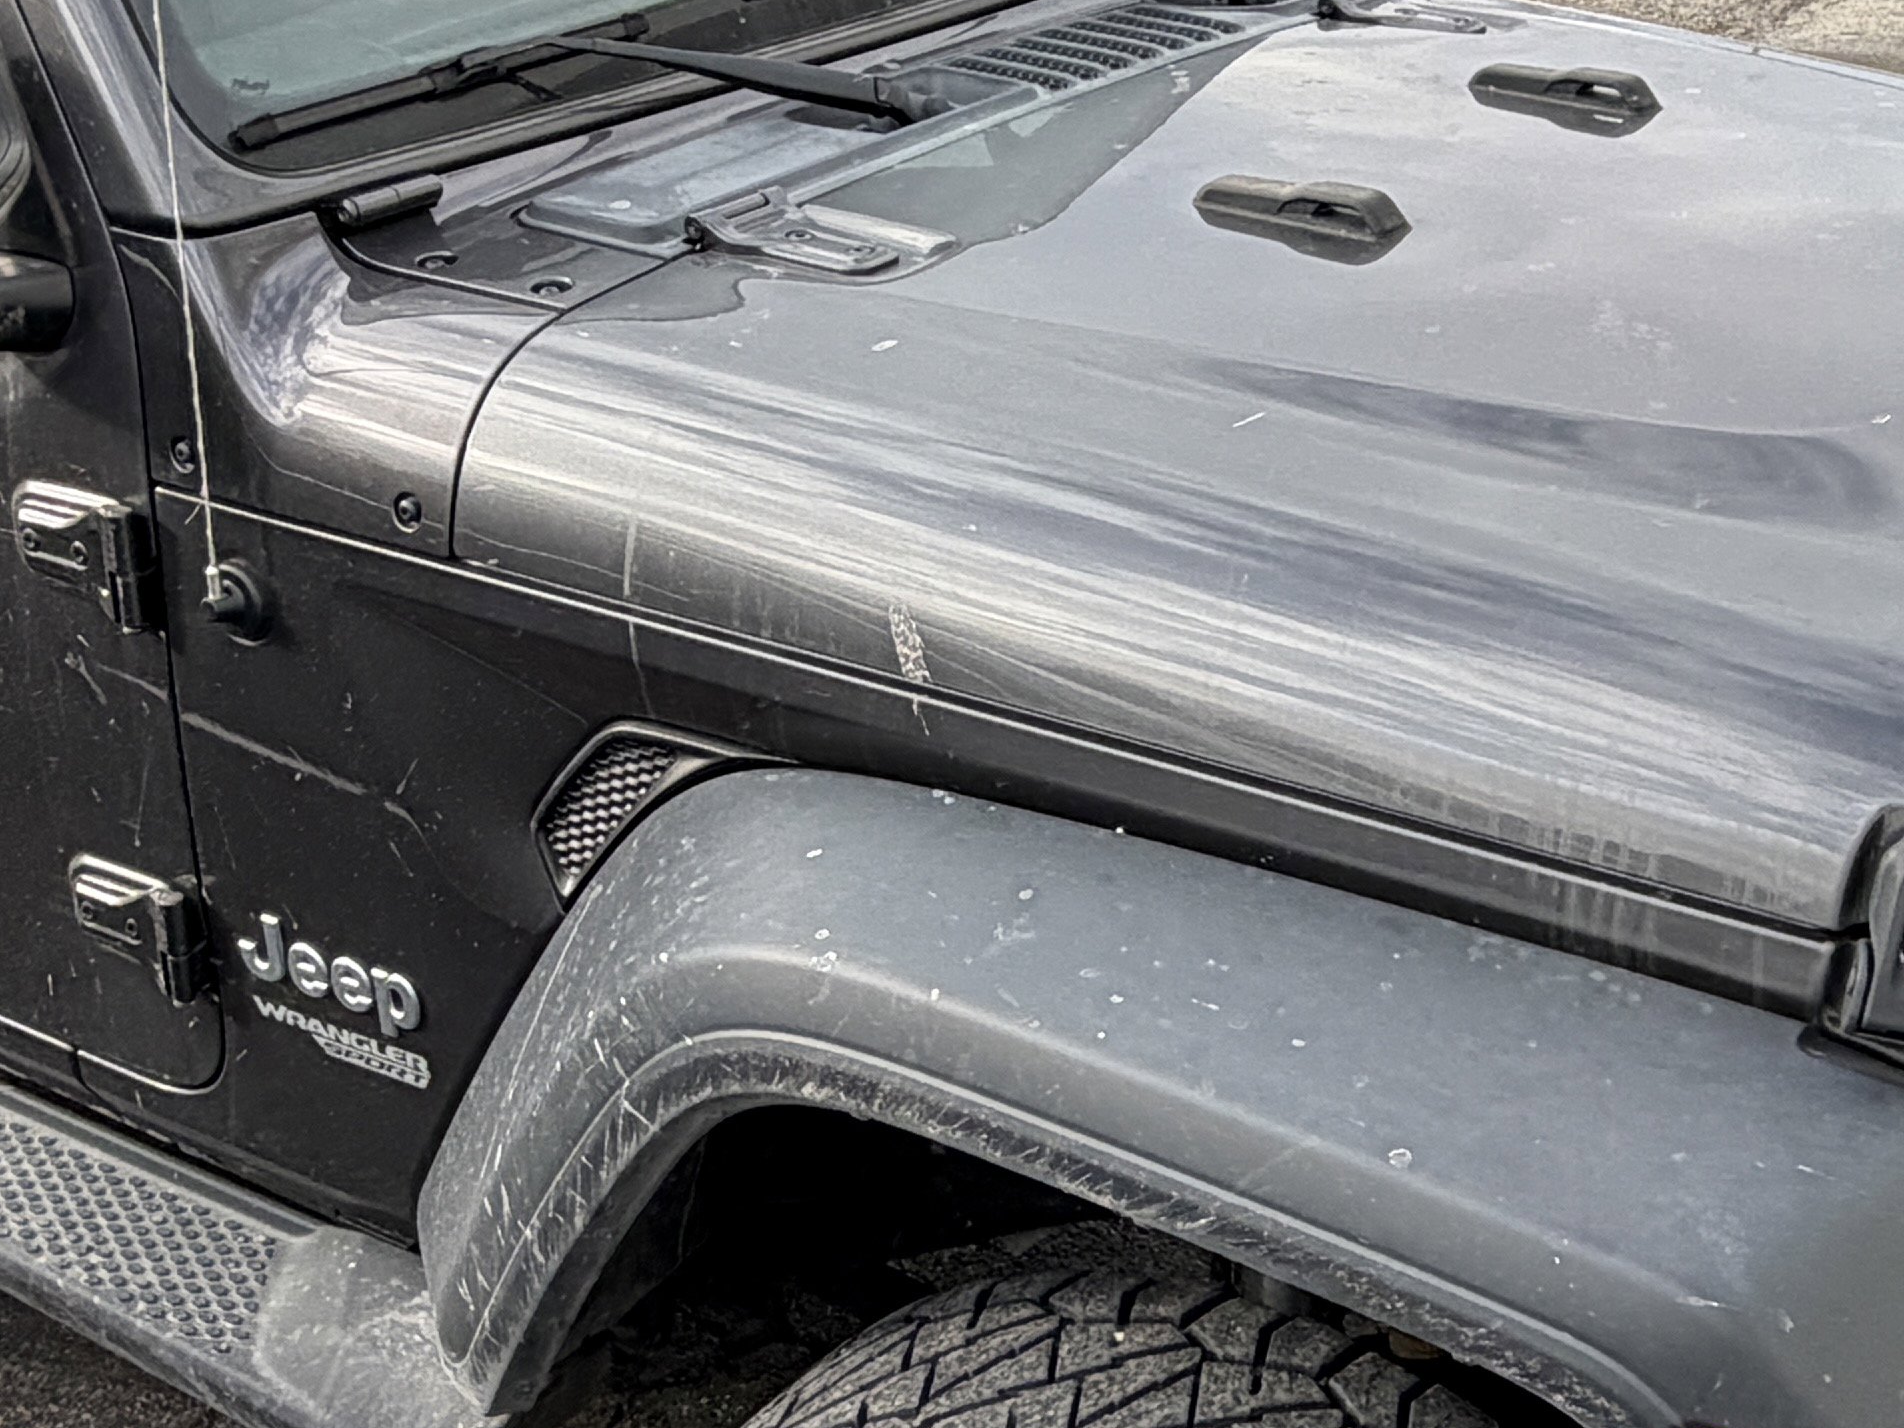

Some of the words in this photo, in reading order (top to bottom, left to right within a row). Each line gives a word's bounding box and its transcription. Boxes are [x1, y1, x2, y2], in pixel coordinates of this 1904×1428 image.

[237, 912, 421, 1037] Jeep
[251, 994, 428, 1071] WRANGLER
[324, 1040, 425, 1085] SPORT
